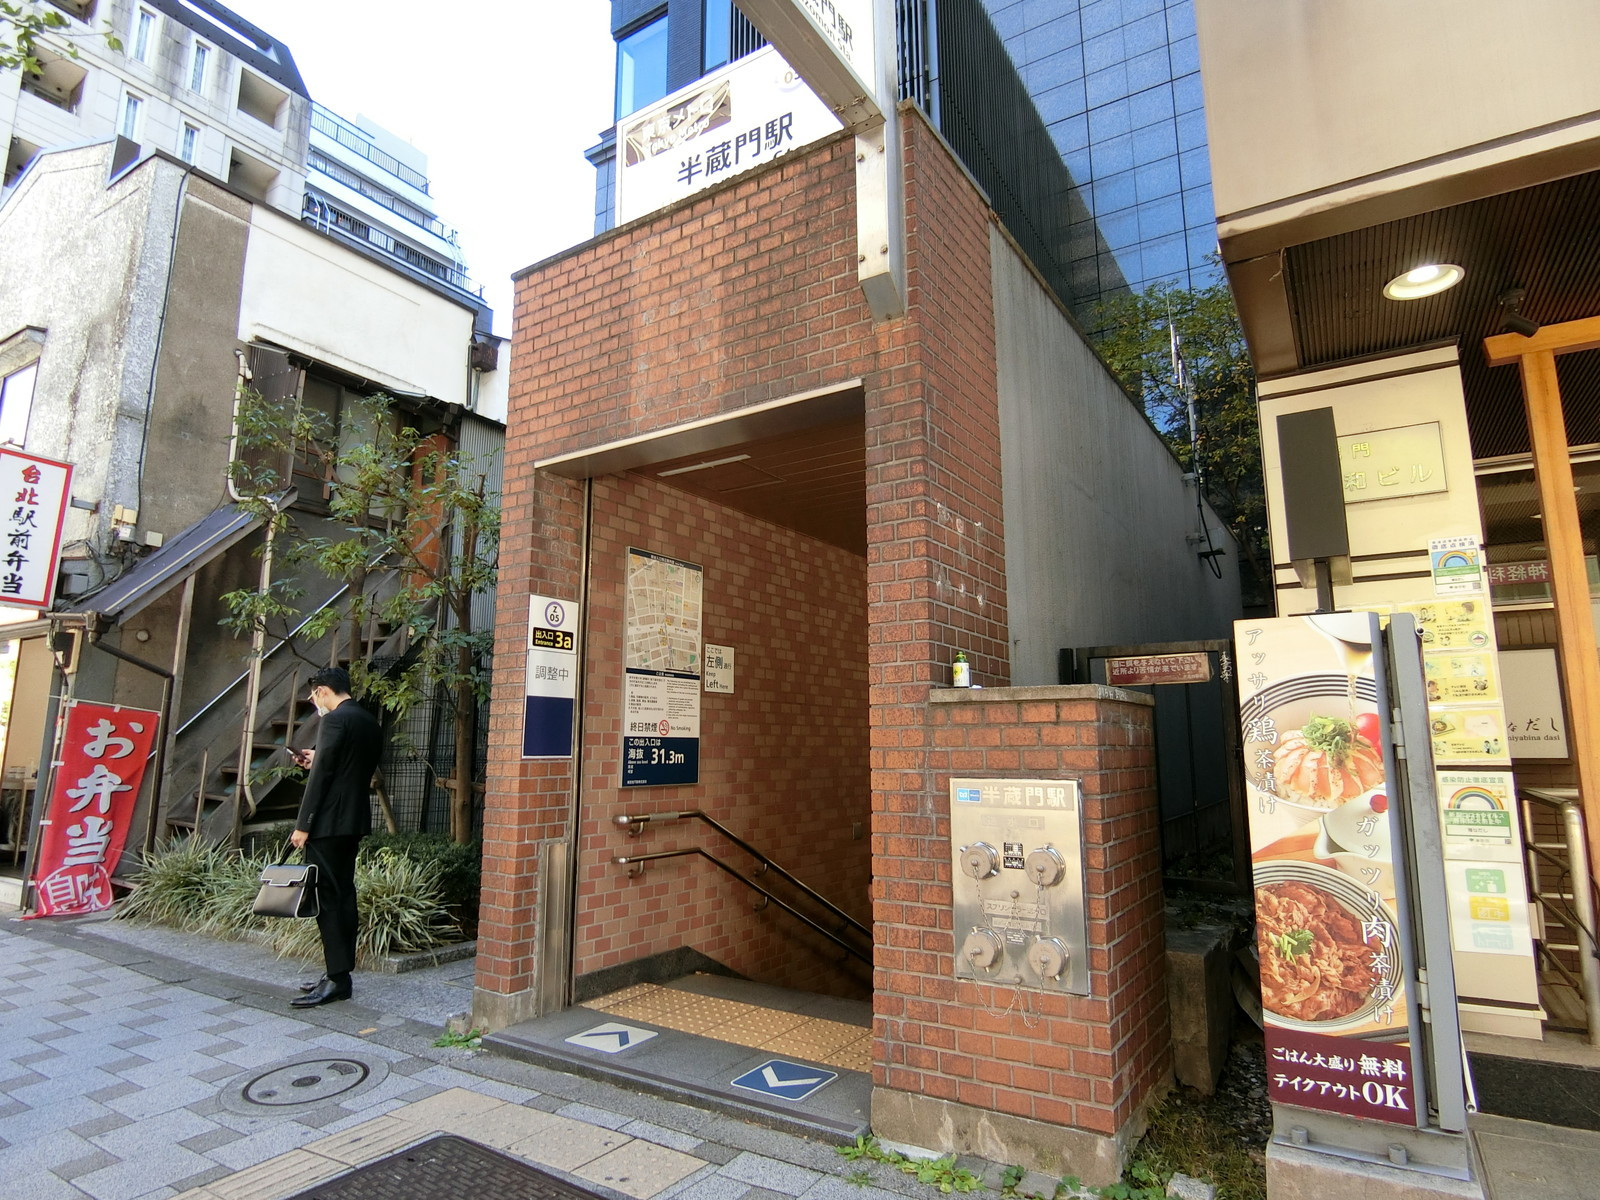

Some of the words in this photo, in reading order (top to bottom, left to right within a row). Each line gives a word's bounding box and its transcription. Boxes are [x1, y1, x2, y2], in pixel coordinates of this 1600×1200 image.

[677, 112, 793, 186] 半蔵門駅
[2, 464, 42, 595] 台北駅前弁当
[549, 613, 560, 623] 05
[552, 605, 558, 614] Z
[535, 629, 554, 641] 出入口
[554, 631, 572, 649] 3a
[535, 665, 569, 682] 調整中
[706, 679, 719, 689] Left
[630, 721, 658, 733] 終日禁煙
[1245, 628, 1278, 815] アッサリ鶏茶漬け
[628, 738, 662, 747] この出入口は
[627, 748, 644, 760] 海抜
[650, 748, 685, 765] 31.3m
[62, 718, 144, 867] お弁当
[981, 785, 1067, 808] 半蔵門駅
[1357, 816, 1395, 1025] ガッツリ肉茶漬け
[1272, 1046, 1355, 1072] ごはん大盛り
[1357, 1054, 1407, 1081] 無料
[1273, 1073, 1361, 1102] テイクアウト
[1362, 1080, 1409, 1111] OK
